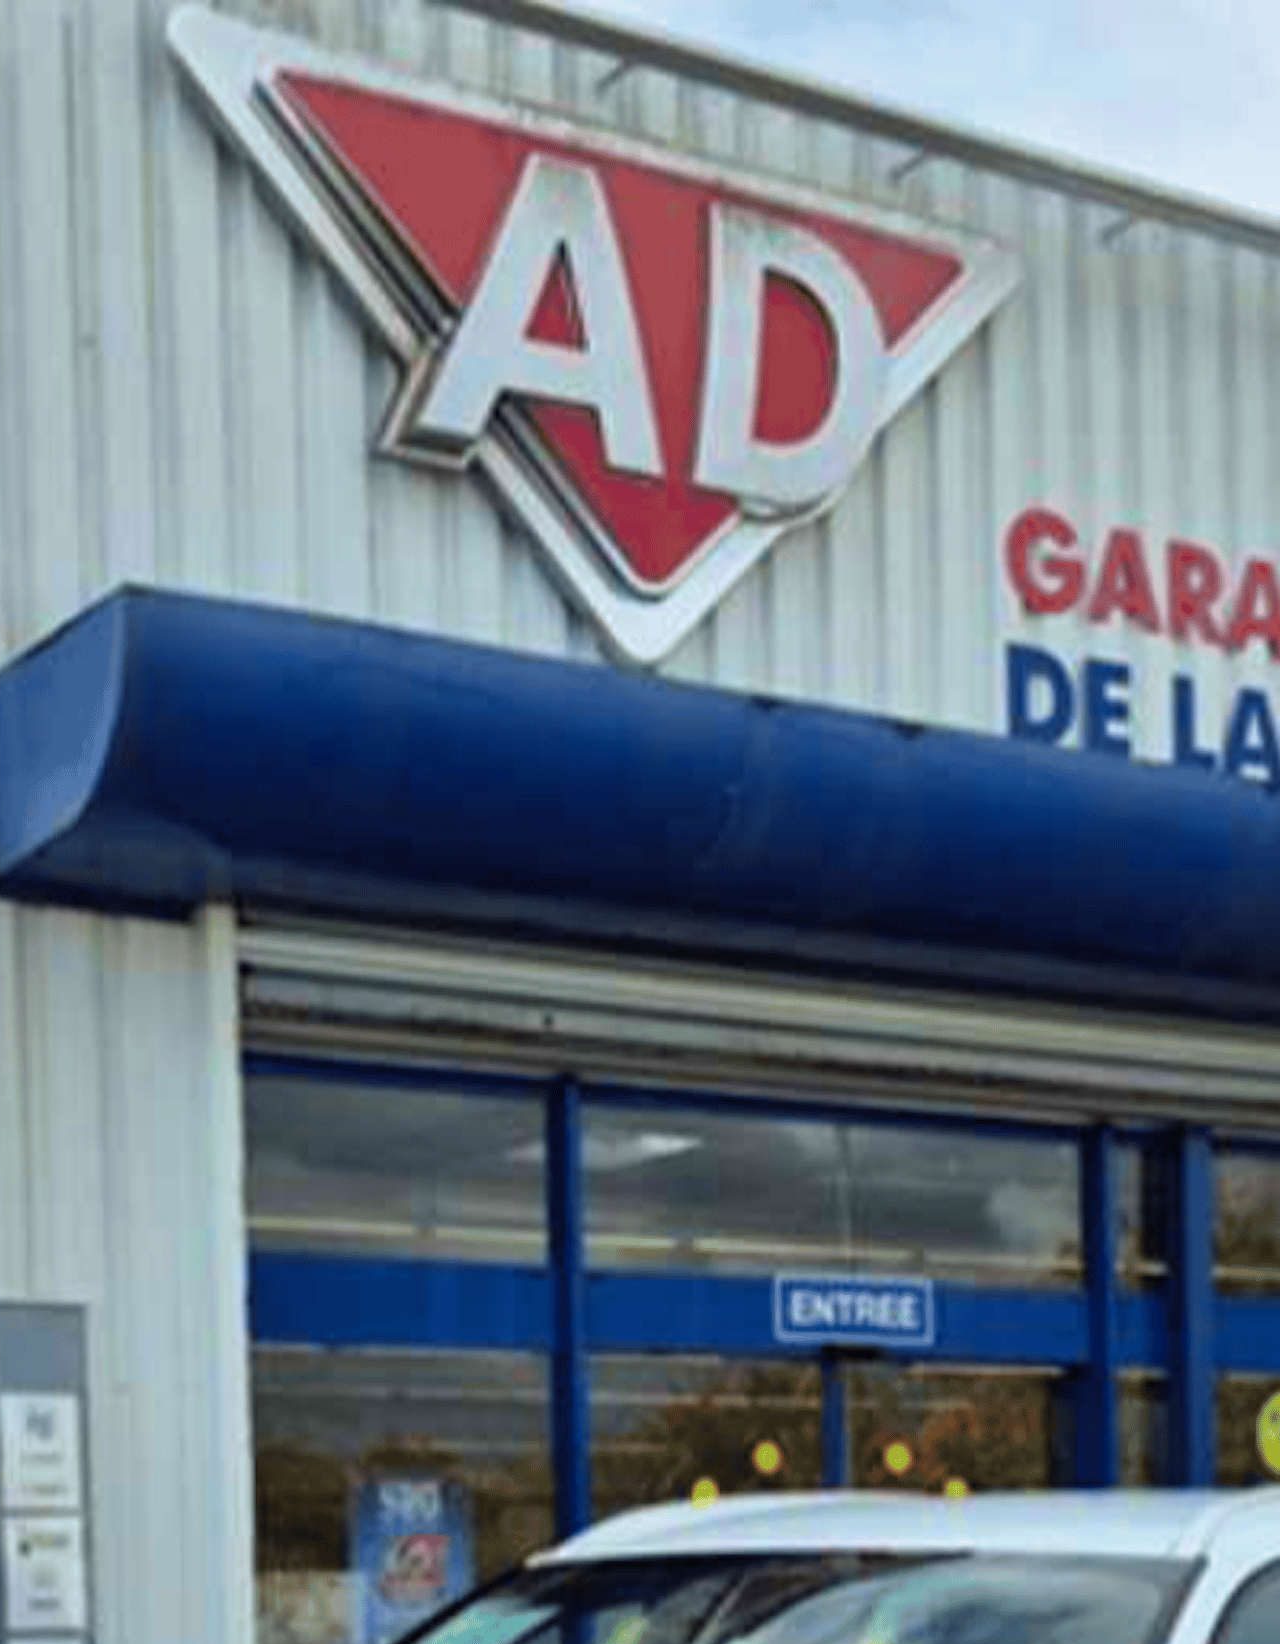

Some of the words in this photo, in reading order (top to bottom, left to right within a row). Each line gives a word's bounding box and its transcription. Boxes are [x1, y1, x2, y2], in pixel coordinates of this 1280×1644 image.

[413, 150, 892, 512] AD
[1006, 643, 1131, 755] DE
[791, 1290, 917, 1329] ENTREE
